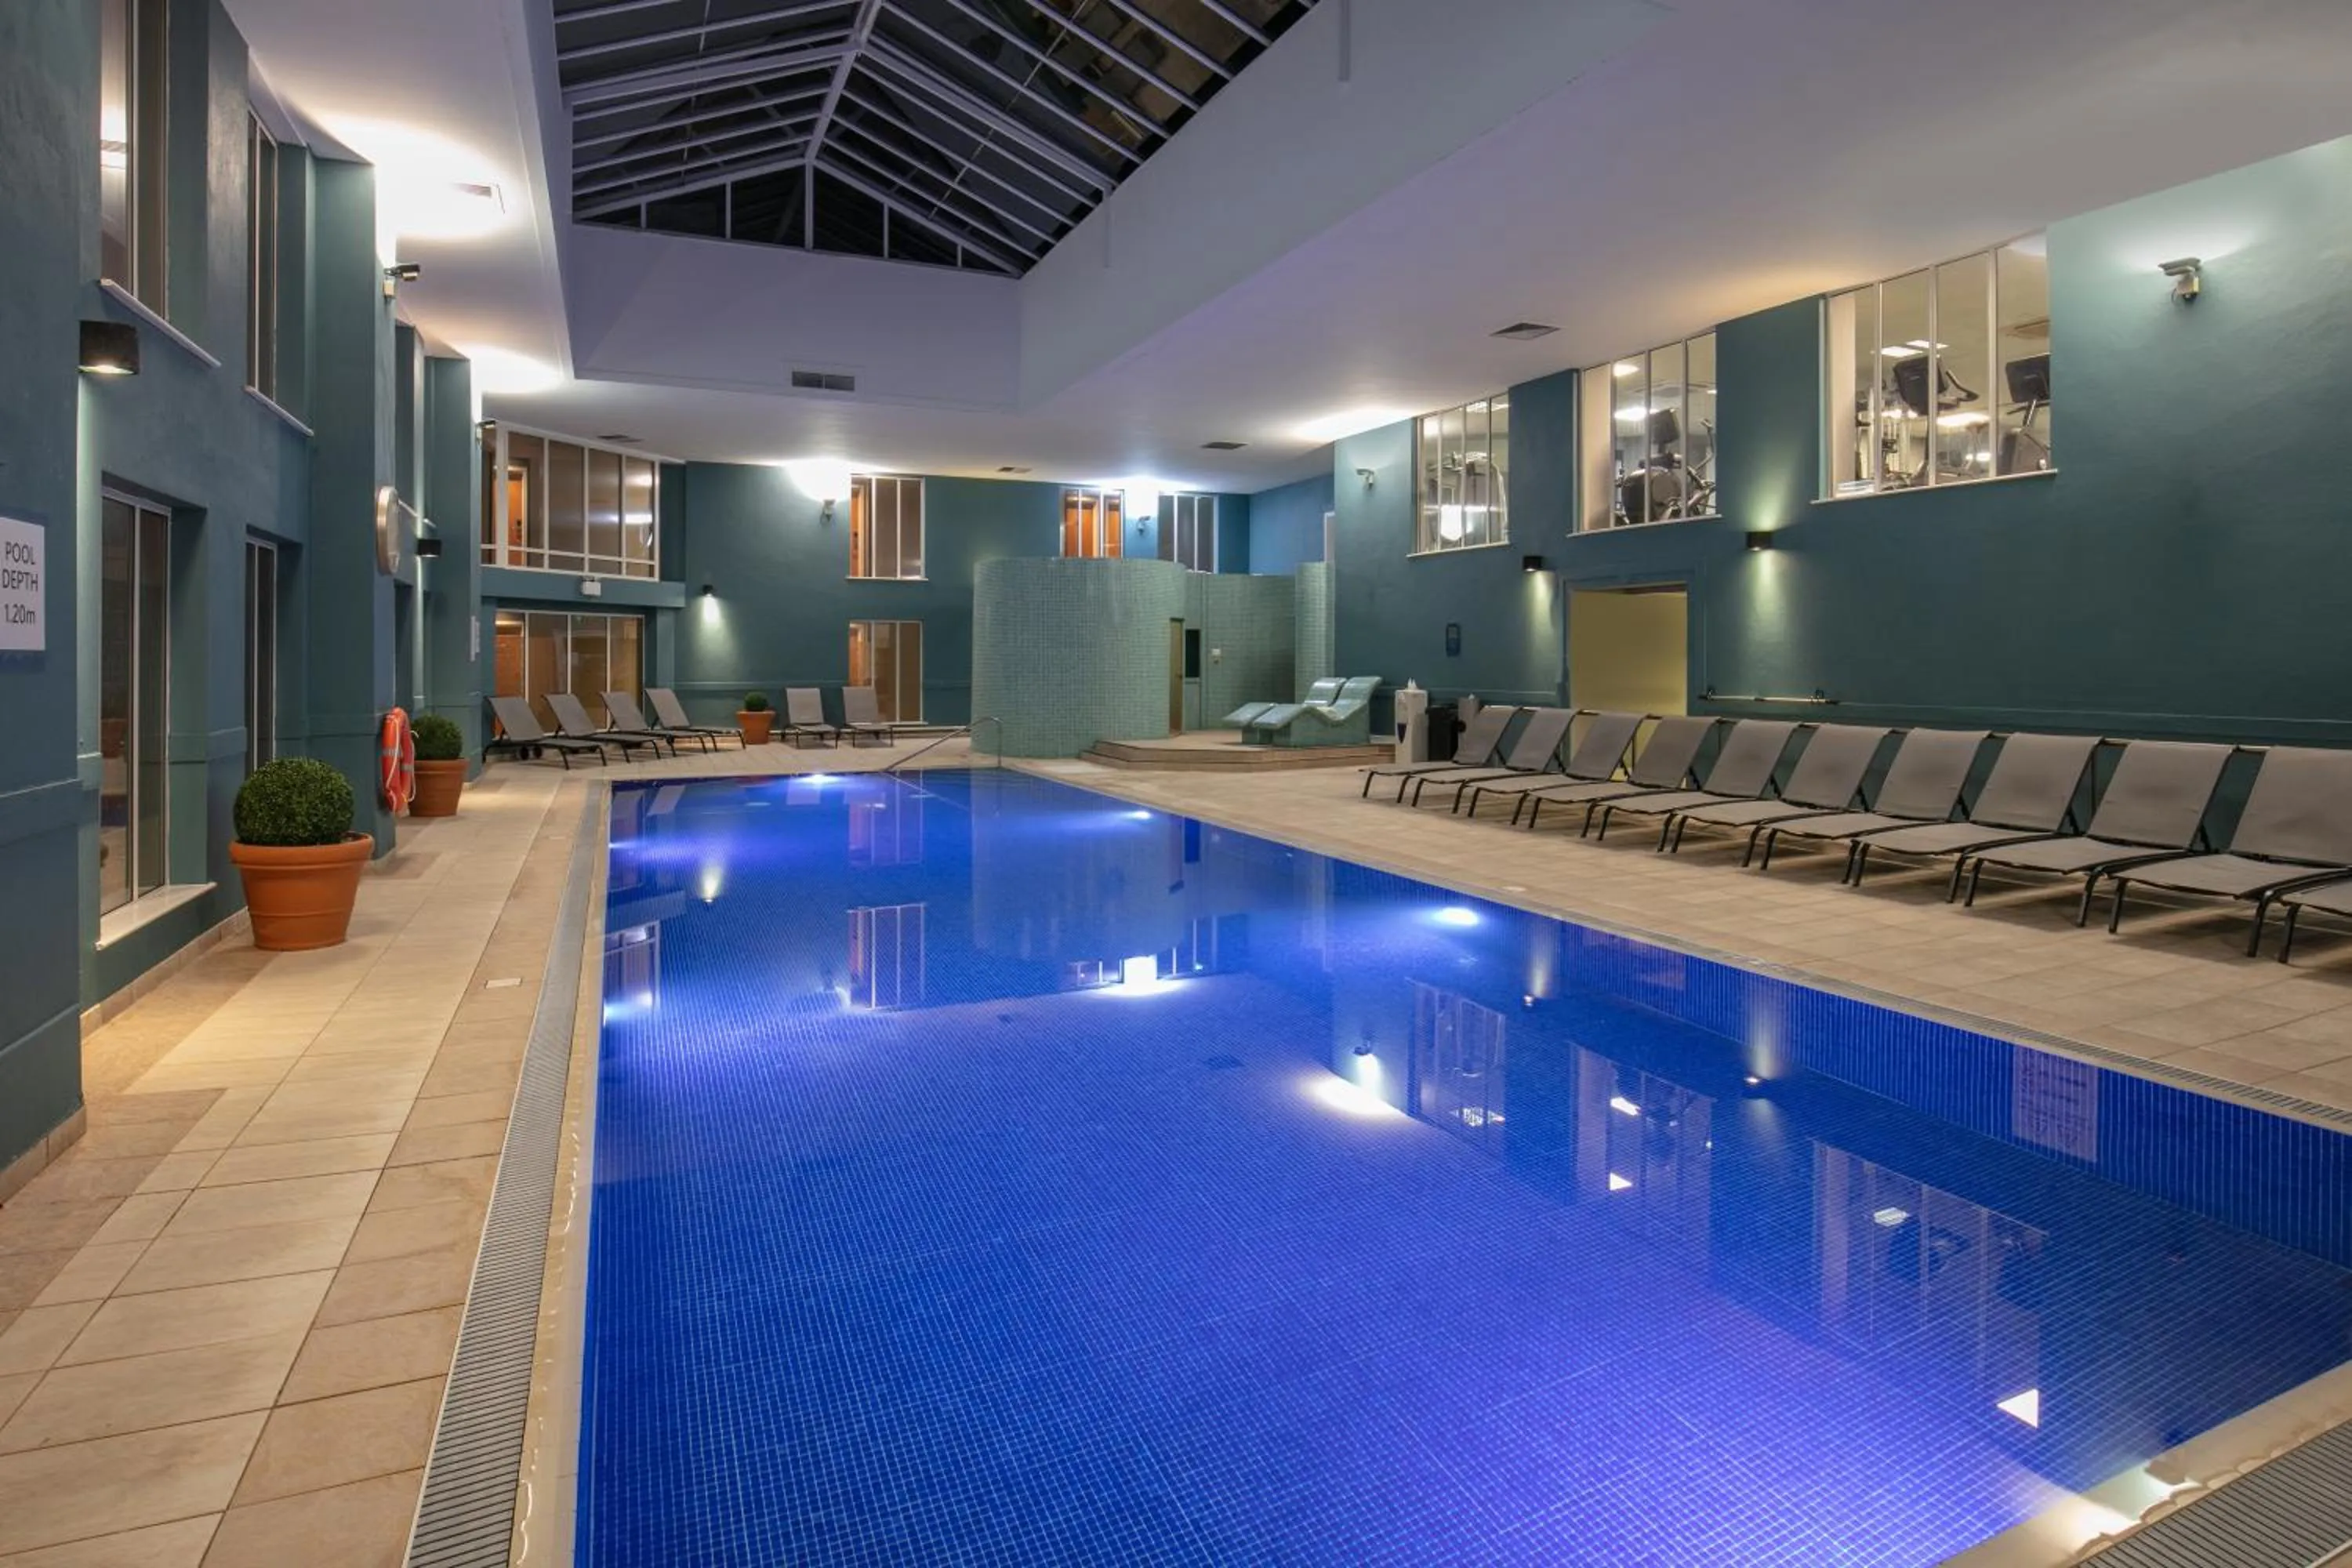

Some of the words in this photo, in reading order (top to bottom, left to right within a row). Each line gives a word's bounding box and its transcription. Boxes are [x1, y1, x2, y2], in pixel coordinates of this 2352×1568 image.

[5, 541, 36, 565] POOL
[2, 568, 38, 591] DEPTH
[4, 603, 35, 624] 1.20m
